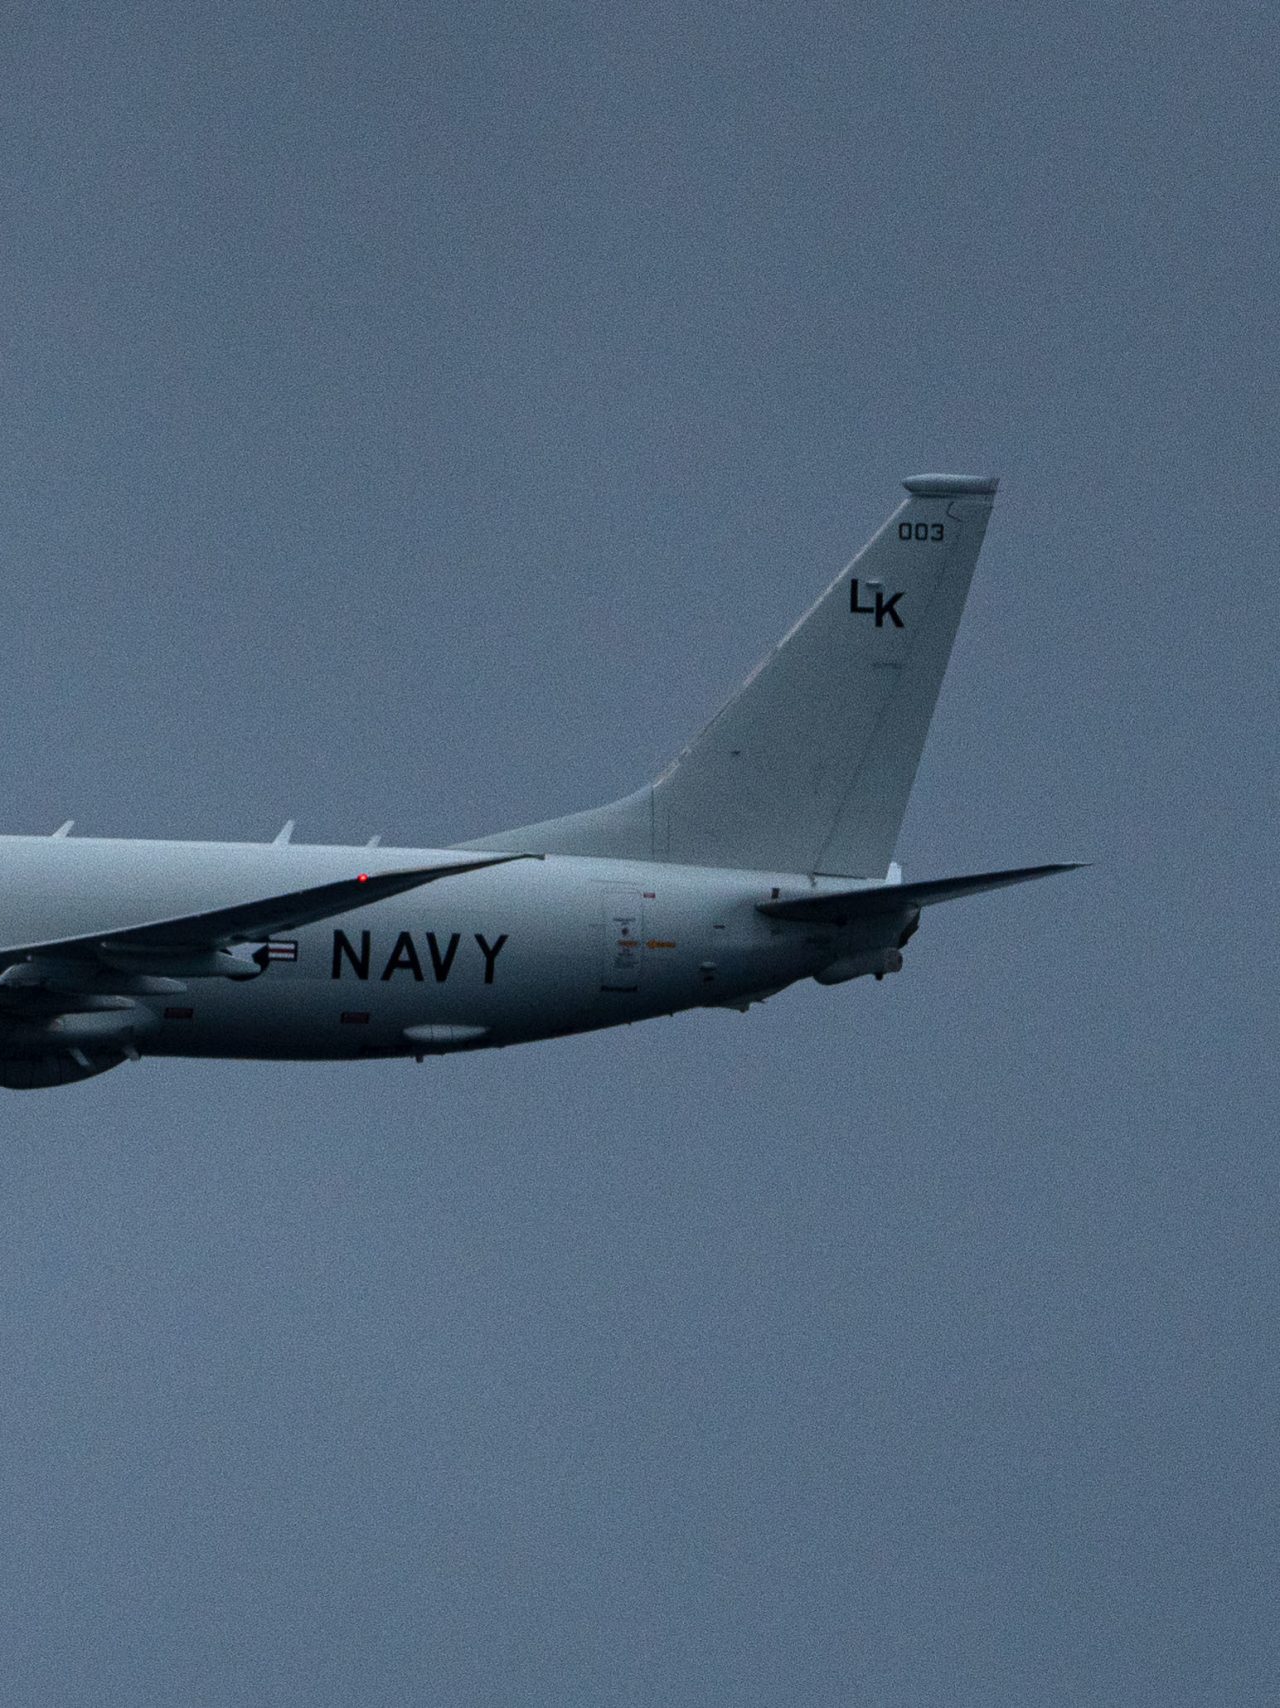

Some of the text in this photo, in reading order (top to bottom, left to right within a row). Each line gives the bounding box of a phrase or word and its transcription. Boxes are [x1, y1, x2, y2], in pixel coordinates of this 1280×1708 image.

[898, 522, 944, 541] 003
[850, 578, 905, 627] LK
[332, 929, 509, 984] NAVY
